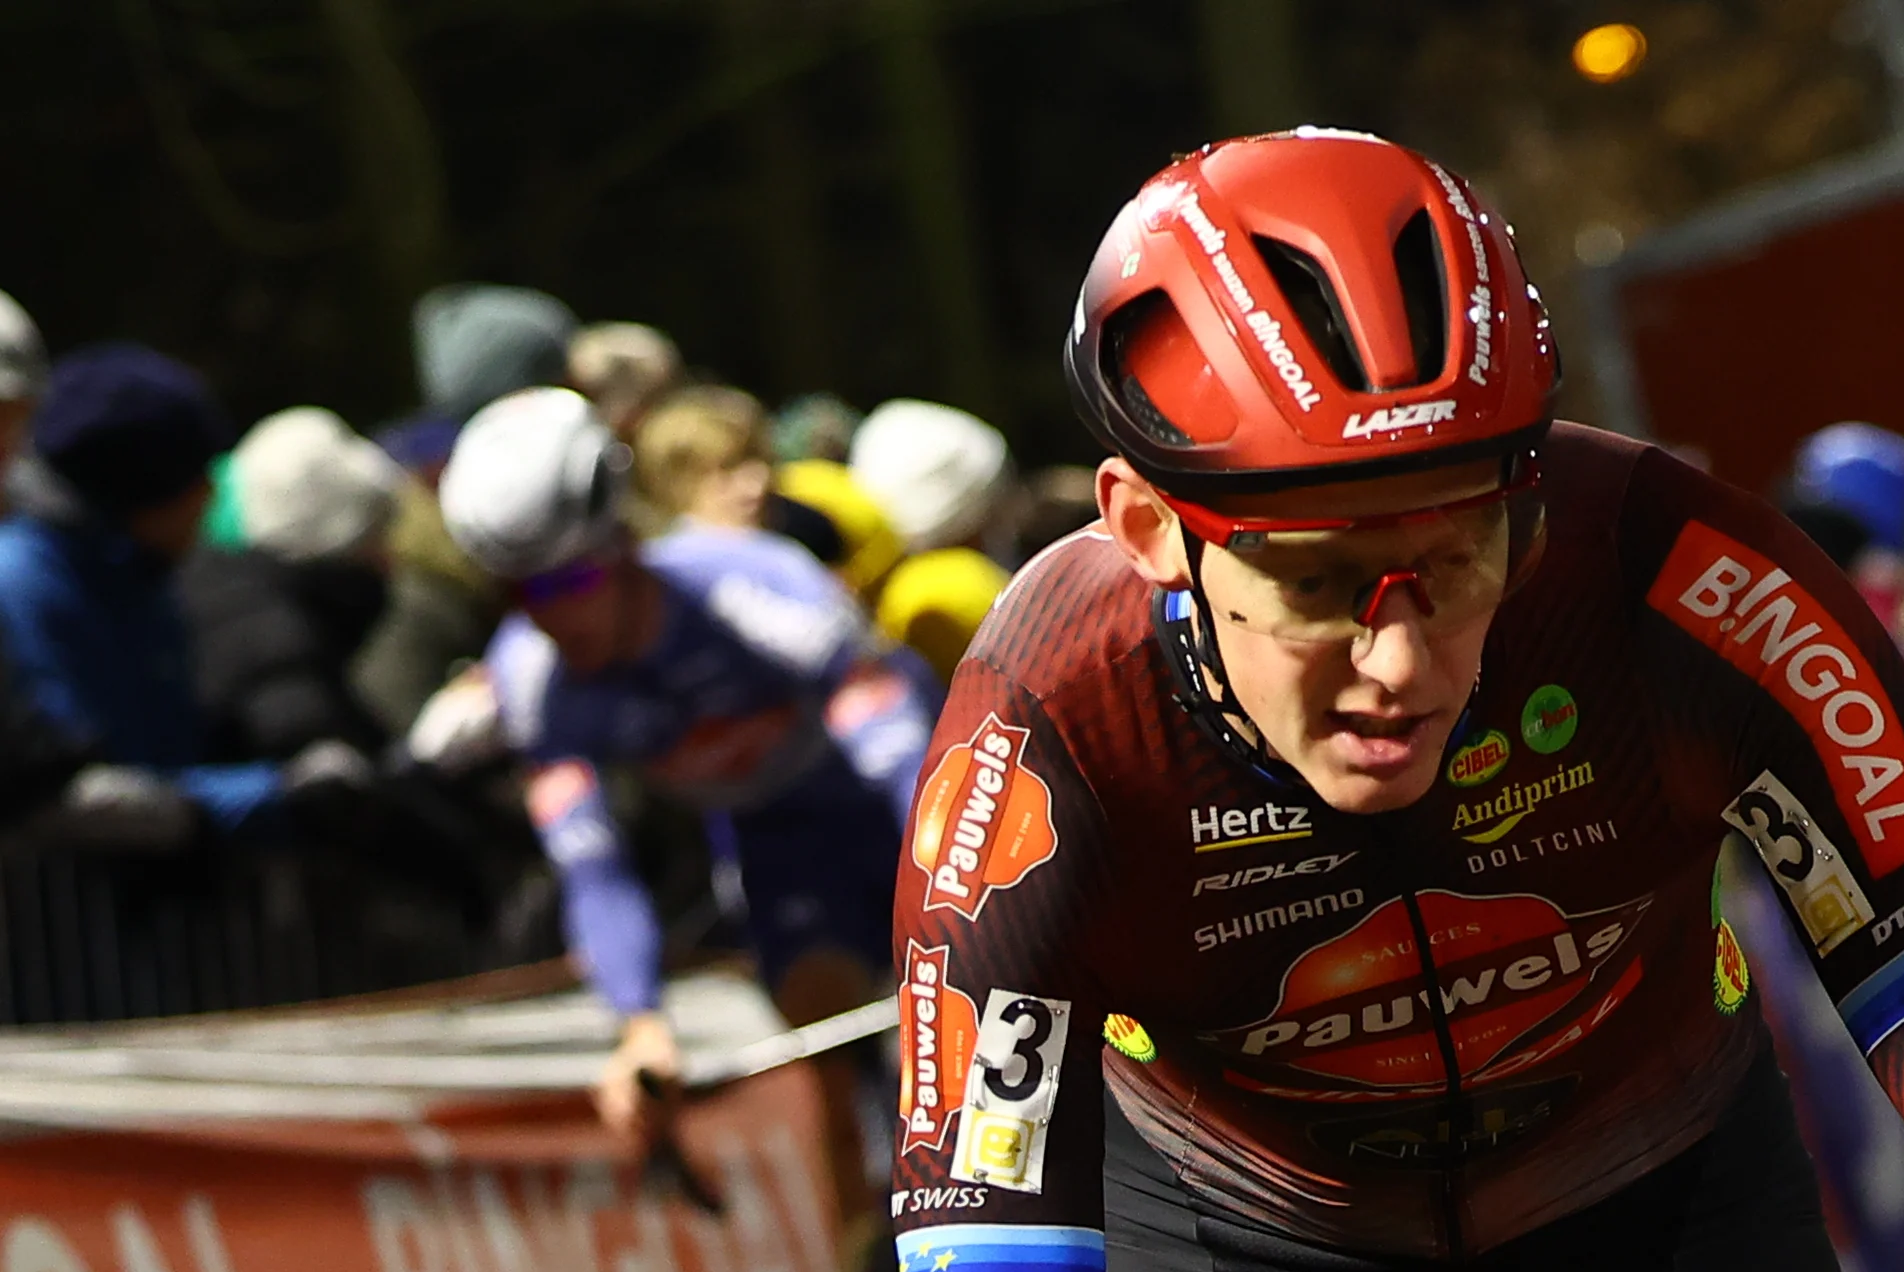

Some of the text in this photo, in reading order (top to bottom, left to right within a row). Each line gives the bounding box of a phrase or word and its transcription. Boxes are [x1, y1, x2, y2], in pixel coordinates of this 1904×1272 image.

[1340, 400, 1458, 439] LAZER
[1451, 742, 1508, 780] CIBEL
[934, 731, 1012, 899] Pauwels
[1191, 802, 1313, 843] Hertz
[1452, 761, 1596, 831] Andiprim
[1467, 820, 1618, 874] DOLTCINI
[1740, 791, 1814, 882] 3
[1192, 851, 1361, 897] RIDLEY
[1194, 888, 1364, 951] SHIMANO
[1361, 921, 1482, 965] SAUCES
[1240, 921, 1626, 1057] Pauwels
[910, 960, 939, 1134] Pauwels
[983, 997, 1053, 1103] 3
[910, 1186, 989, 1213] SWISS
